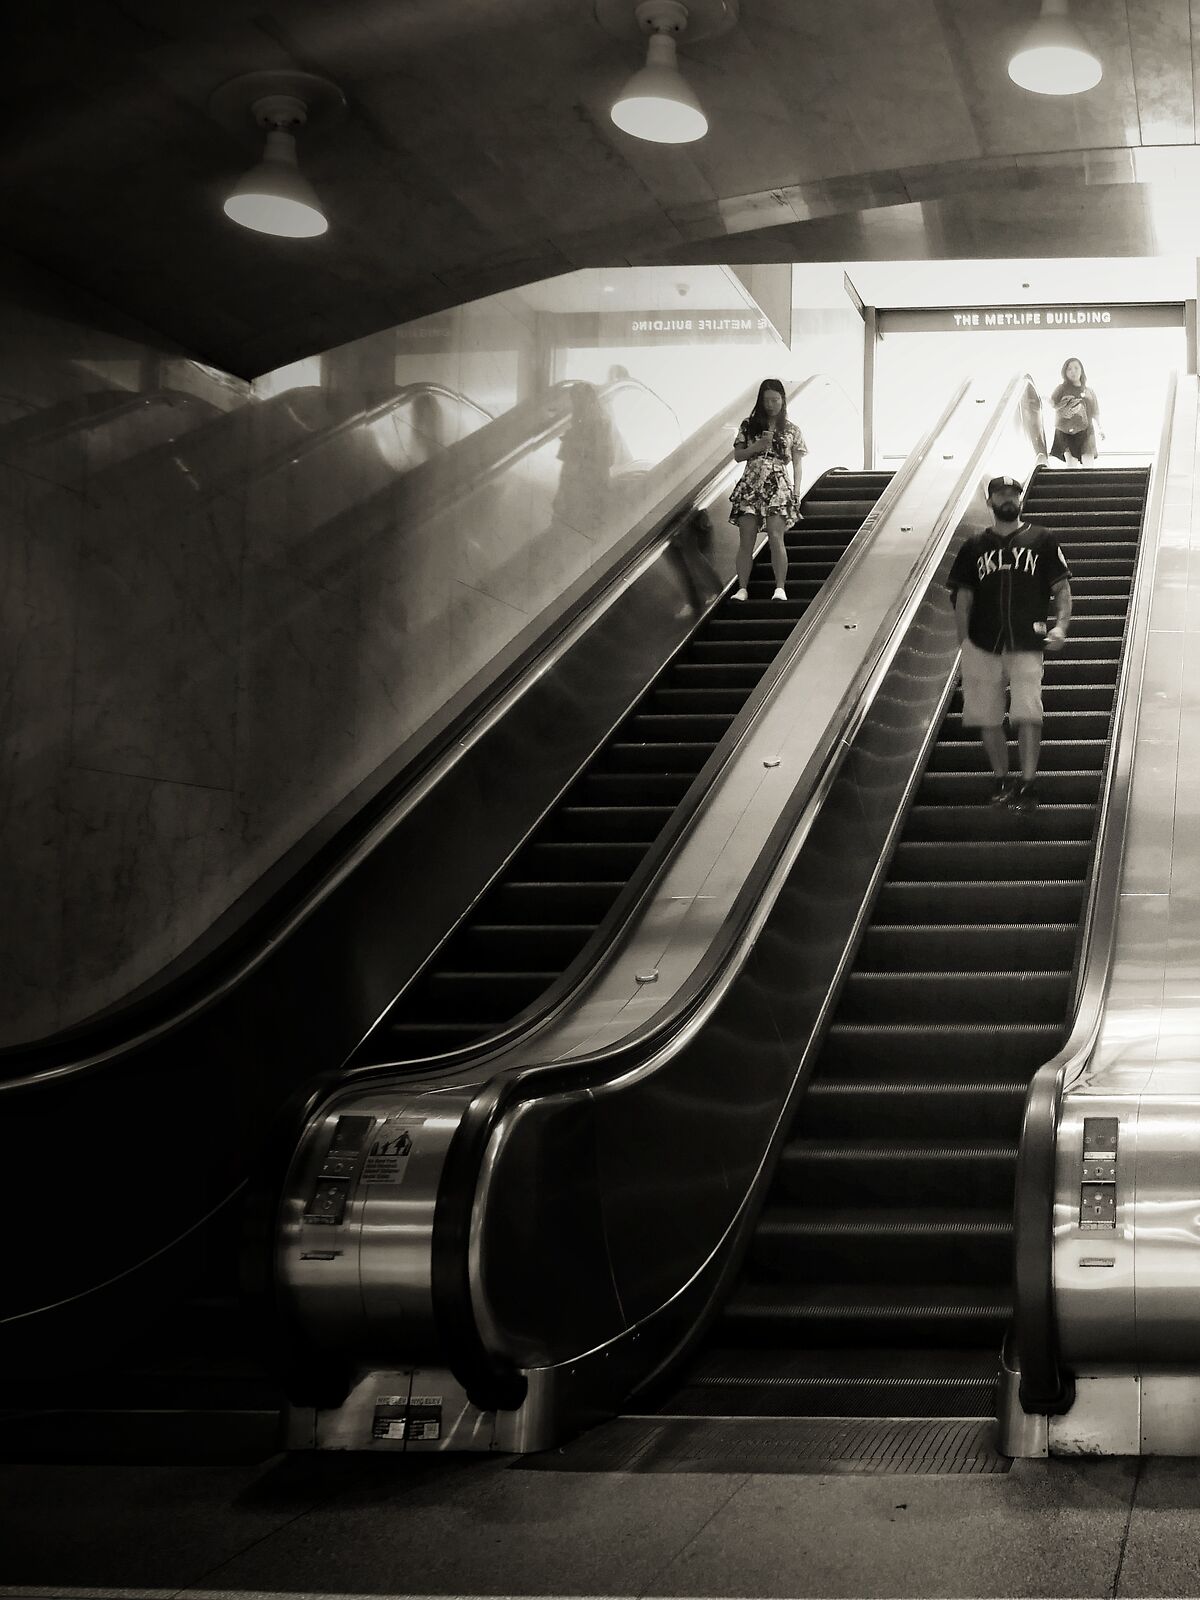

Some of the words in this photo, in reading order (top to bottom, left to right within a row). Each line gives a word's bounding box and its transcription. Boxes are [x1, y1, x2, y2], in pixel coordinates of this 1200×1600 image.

[953, 314, 979, 326] THE
[984, 313, 1041, 326] METLIFE
[1046, 312, 1112, 324] BUILDING
[977, 547, 1039, 581] BKLYN
